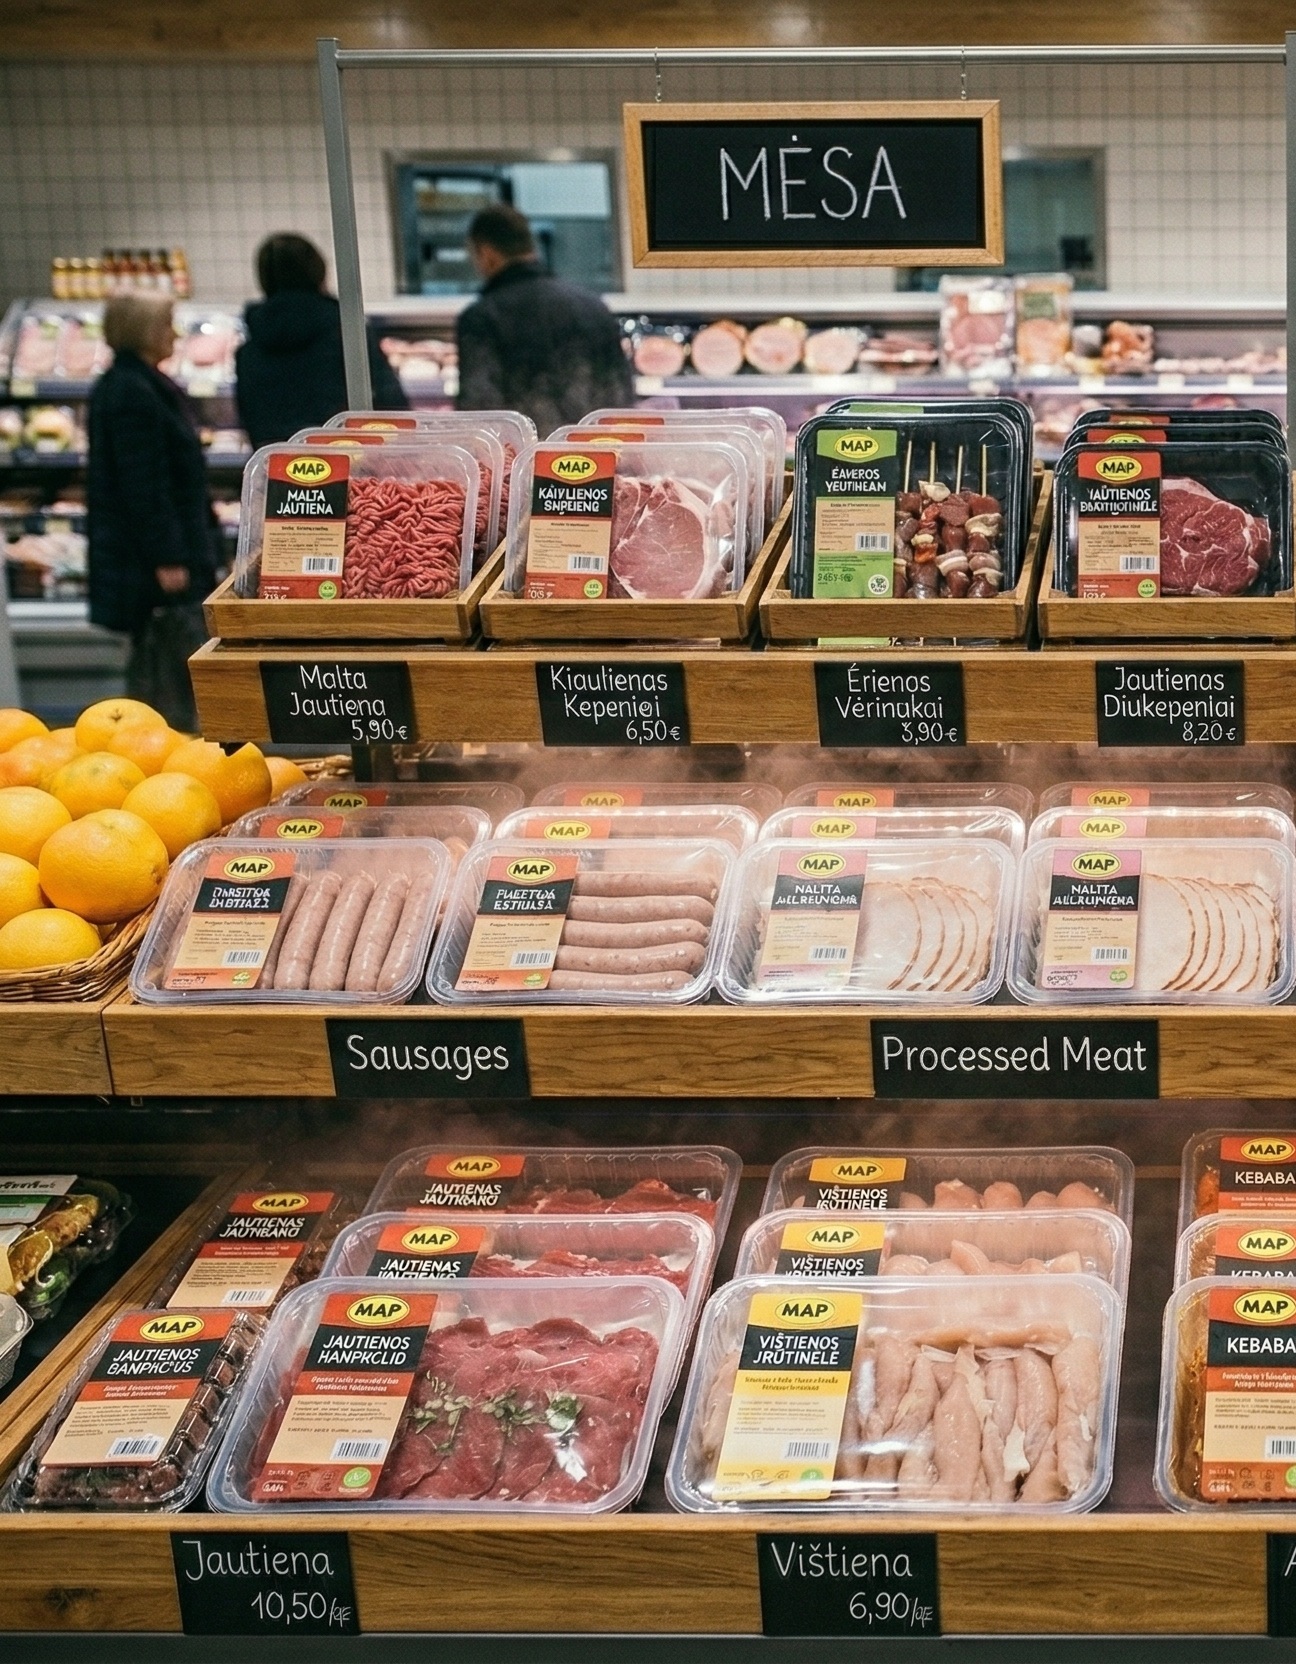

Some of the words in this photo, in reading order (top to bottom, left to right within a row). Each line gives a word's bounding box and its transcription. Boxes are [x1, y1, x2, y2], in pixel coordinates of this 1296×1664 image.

[720, 134, 907, 221] MĖSA
[840, 440, 873, 452] MAP
[292, 463, 326, 476] MAP
[557, 461, 591, 473] MAP
[1102, 462, 1135, 474] MAP
[287, 489, 326, 502] MALTA
[276, 502, 334, 515] JAUTIENA
[299, 664, 368, 691] Malta
[1114, 666, 1225, 692] Jautienas
[289, 691, 386, 717] Jautiena
[328, 798, 363, 808] MAP
[585, 798, 619, 807] MAP
[838, 798, 871, 807] MAP
[1093, 796, 1127, 806] MAP
[283, 825, 318, 834] MAP
[549, 826, 585, 836] MAP
[816, 824, 851, 833] MAP
[1085, 824, 1121, 833] MAP
[230, 862, 269, 874] MAP
[512, 864, 551, 875] MAP
[803, 859, 840, 870] MAP
[1078, 859, 1115, 871] MAP
[346, 1034, 510, 1081] Sausages
[882, 1036, 1050, 1072] Processed
[1062, 1036, 1147, 1072] Meat
[1248, 1145, 1287, 1155] MAP
[453, 1161, 493, 1172] MAP
[837, 1165, 877, 1176] MAP
[259, 1197, 302, 1208] MAP
[408, 1233, 452, 1245] MAP
[811, 1231, 855, 1243] MAP
[1246, 1237, 1288, 1250] MAP
[380, 1259, 461, 1272] JAUTIENAS
[354, 1303, 402, 1317] MAP
[781, 1303, 829, 1318] MAP
[1242, 1300, 1289, 1314] MAP
[147, 1321, 197, 1334] MAP
[323, 1335, 411, 1350] JAUTIENOS
[113, 1348, 201, 1362] JAUTIENOS
[182, 1540, 335, 1582] Jautiena
[771, 1541, 914, 1578] Vištiena
